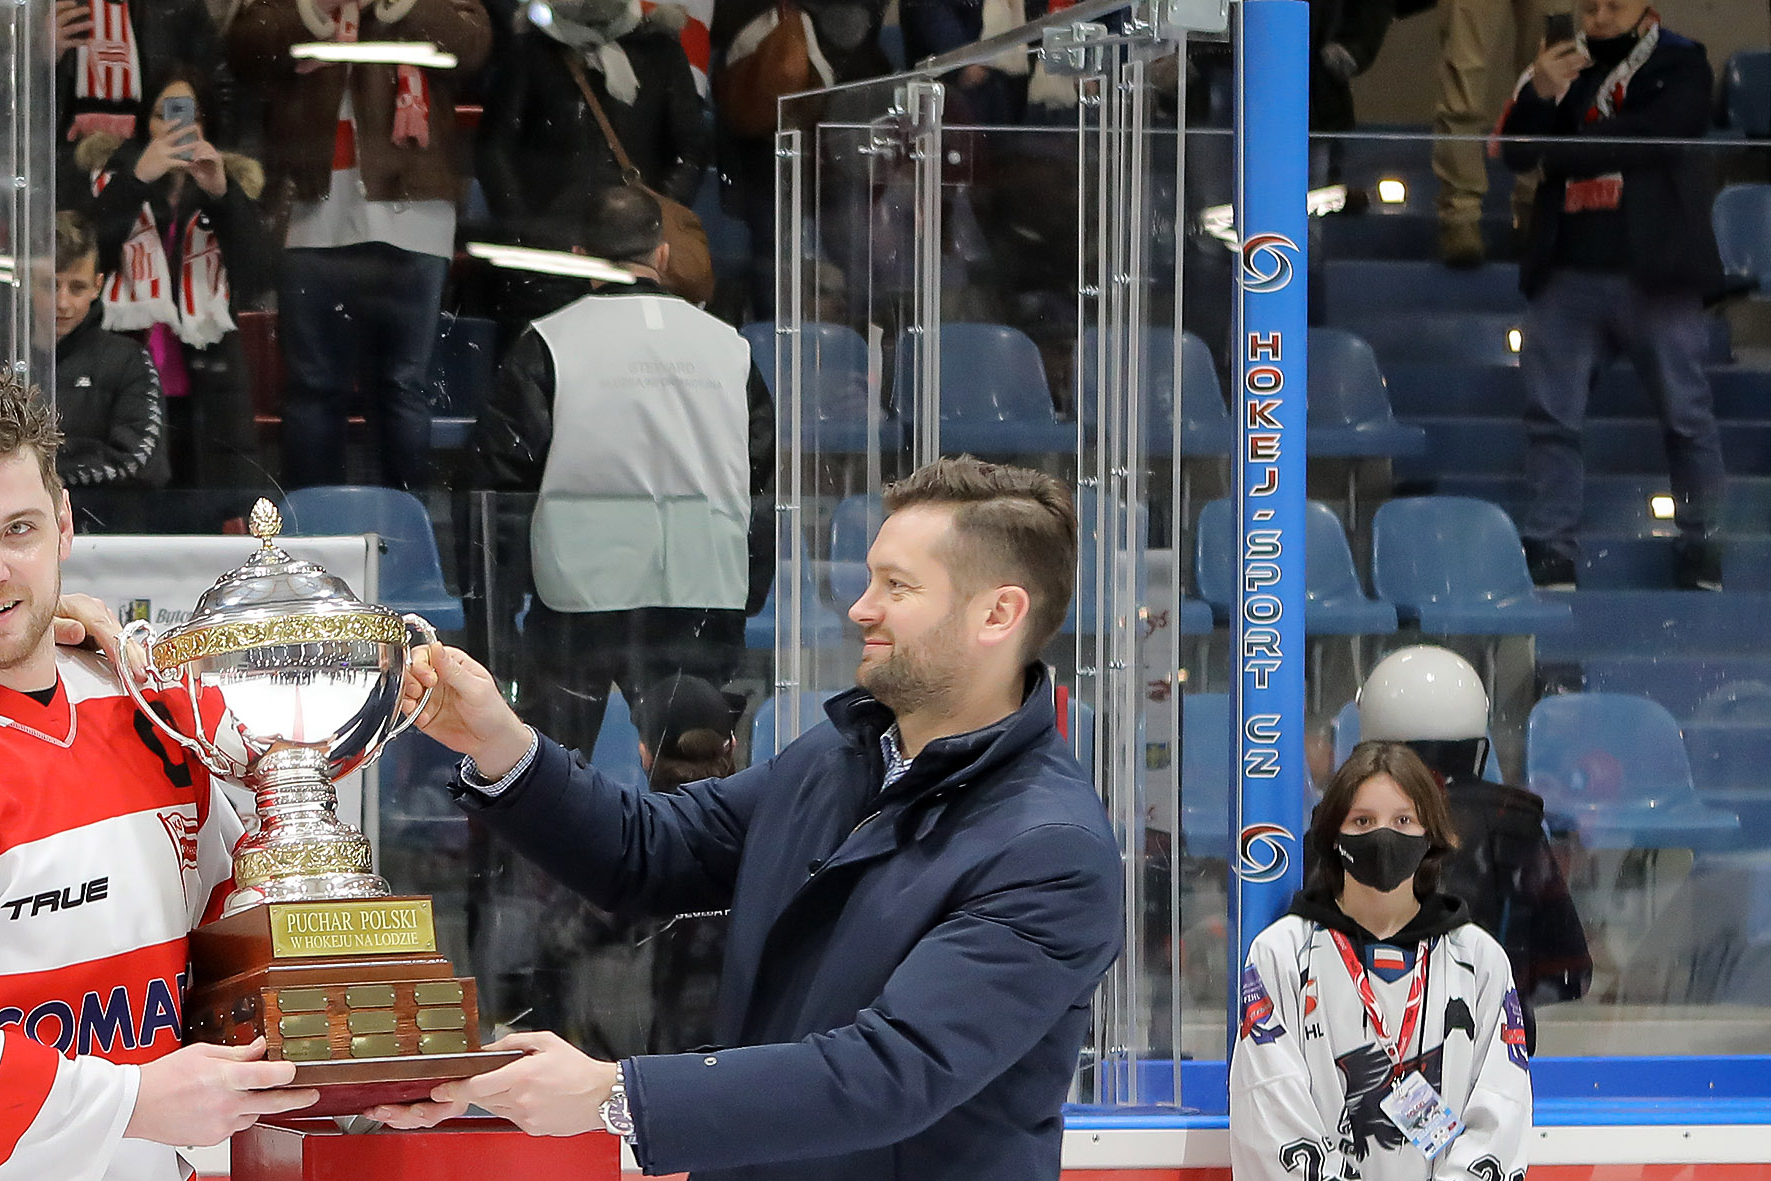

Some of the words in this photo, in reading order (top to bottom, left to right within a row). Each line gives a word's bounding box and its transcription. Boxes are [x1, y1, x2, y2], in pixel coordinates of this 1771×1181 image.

[156, 608, 194, 625] Byto
[1245, 714, 1282, 779] CZ
[0, 876, 109, 921] TRUE
[287, 911, 354, 933] PUCHAR
[359, 909, 418, 930] POLSKI
[290, 936, 303, 949] W
[304, 934, 352, 949] HOKEJU
[354, 933, 373, 947] NA
[374, 931, 420, 947] LODZIE
